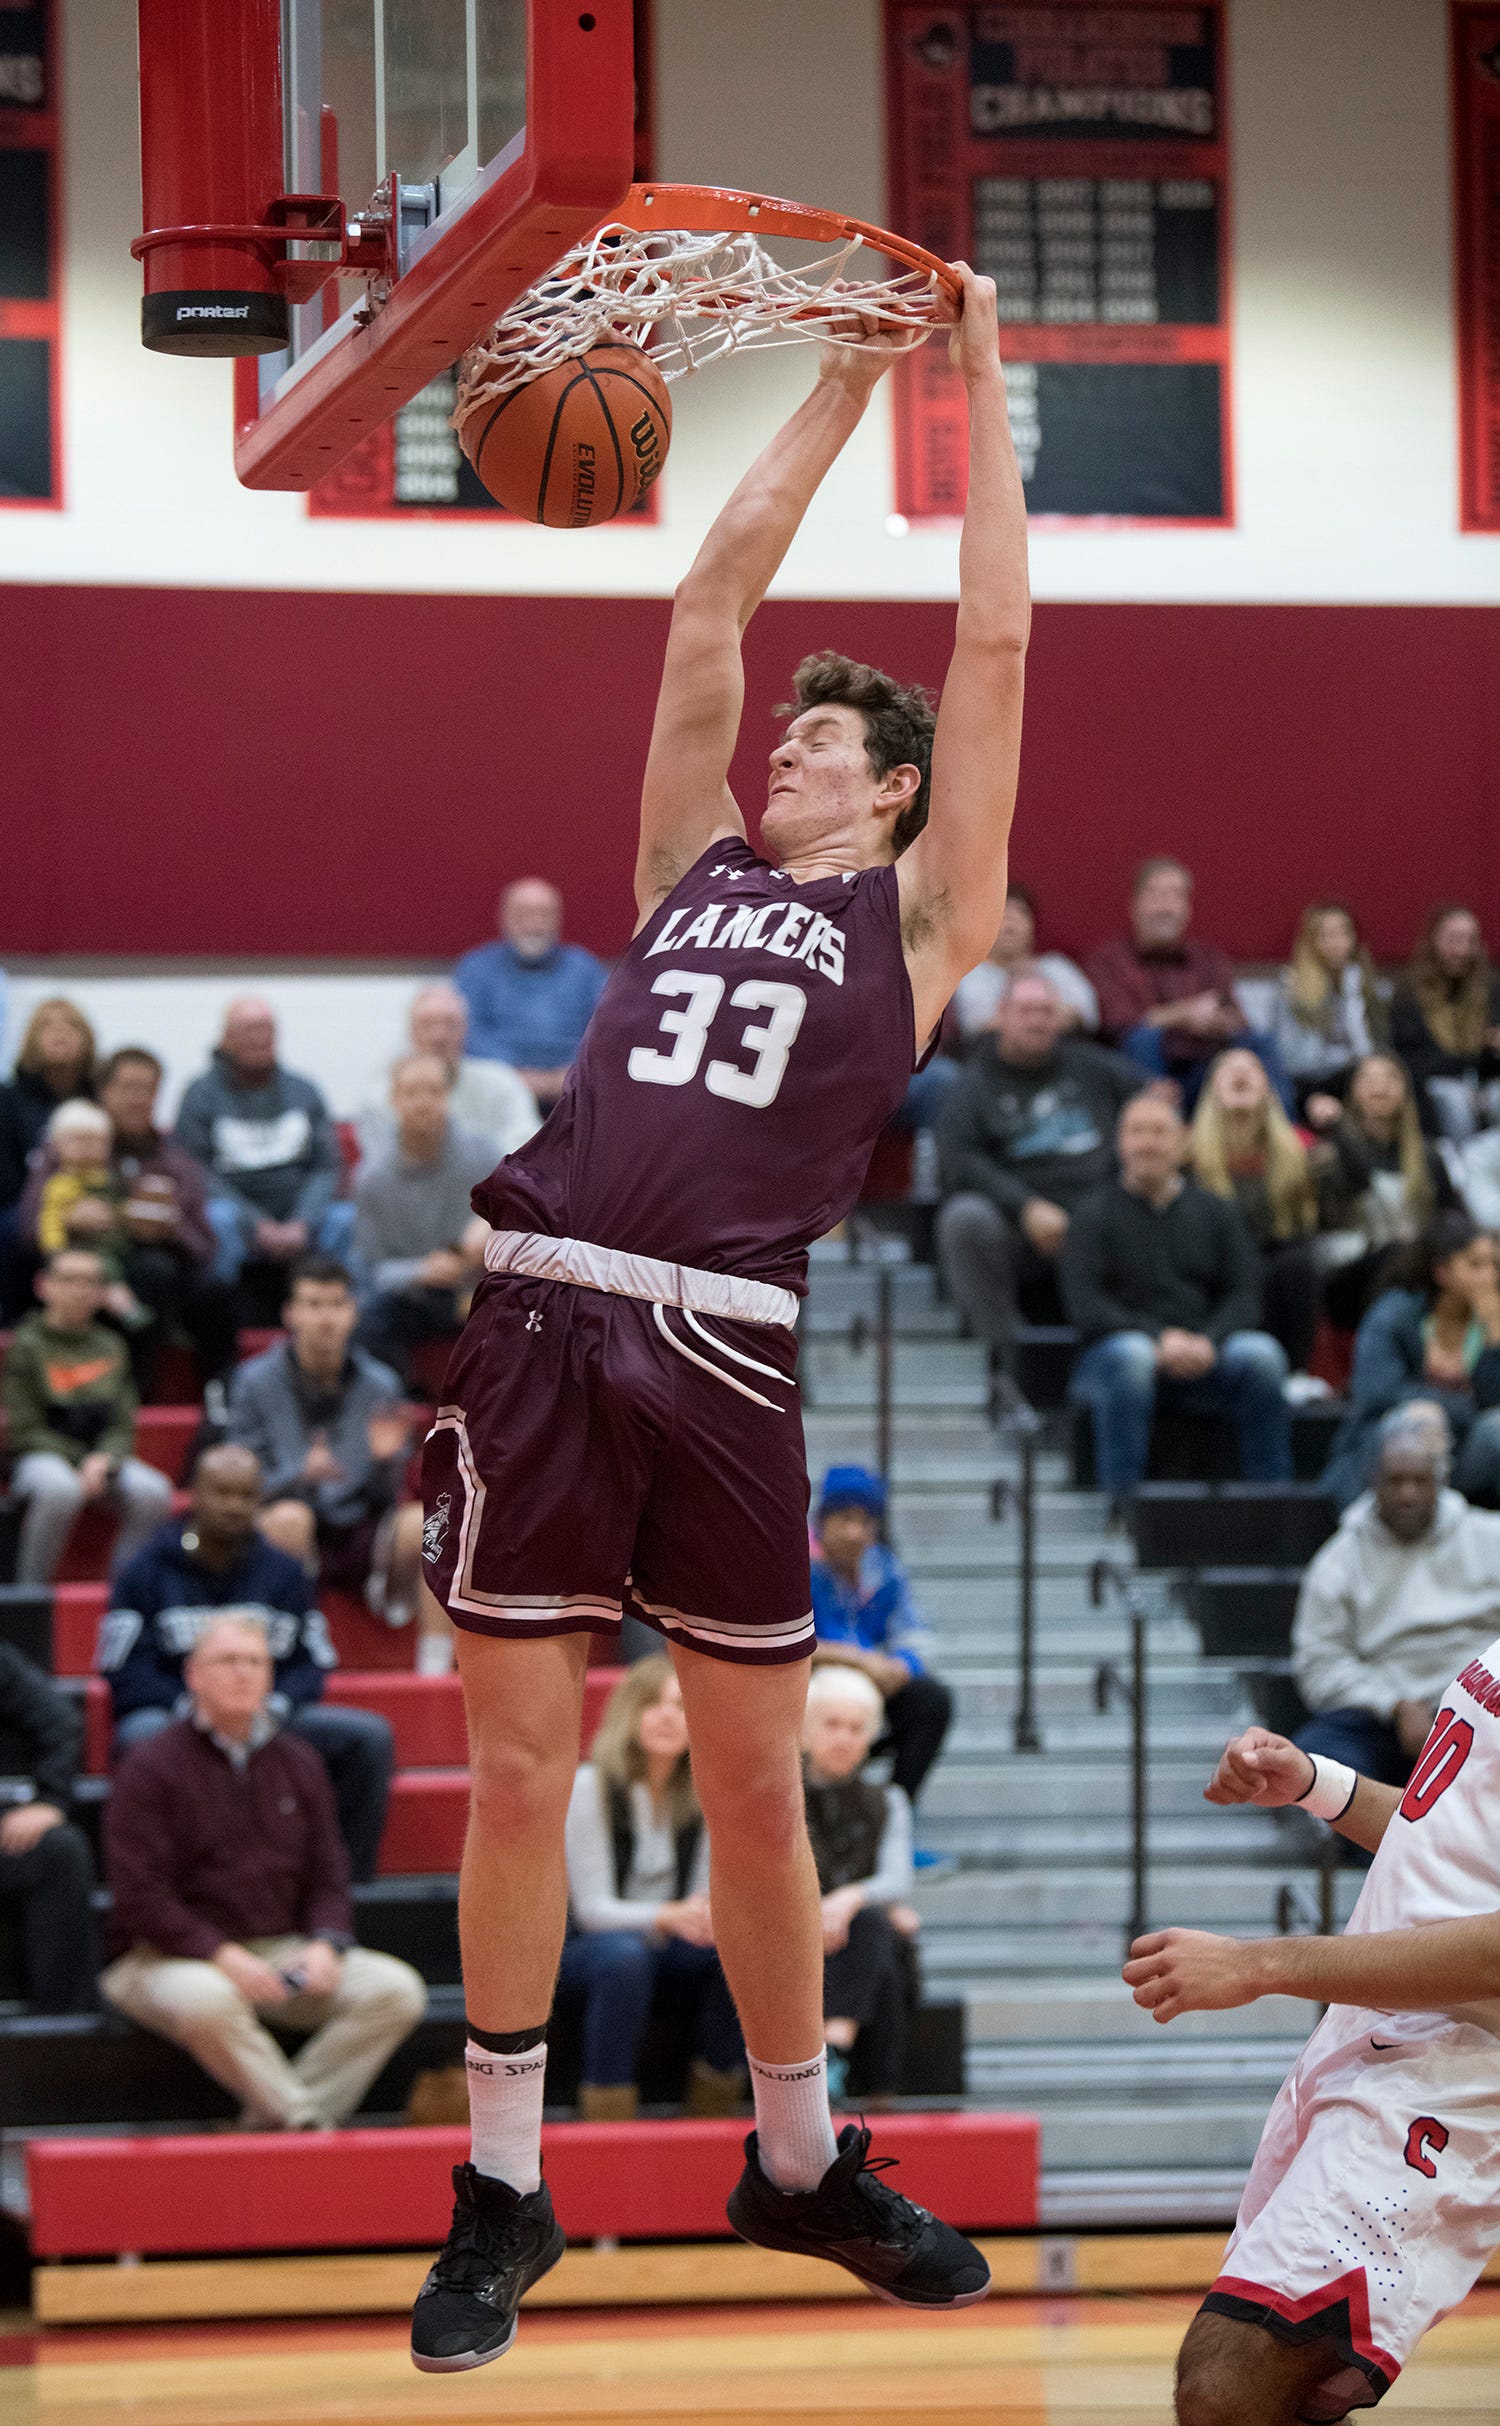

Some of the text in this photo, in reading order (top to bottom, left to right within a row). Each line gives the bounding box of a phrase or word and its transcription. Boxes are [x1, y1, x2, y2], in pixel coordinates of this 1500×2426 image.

[643, 901, 846, 986] LANCERS
[627, 969, 807, 1109] 33
[1400, 1707, 1475, 1823] 10
[1403, 2116, 1449, 2178] C
